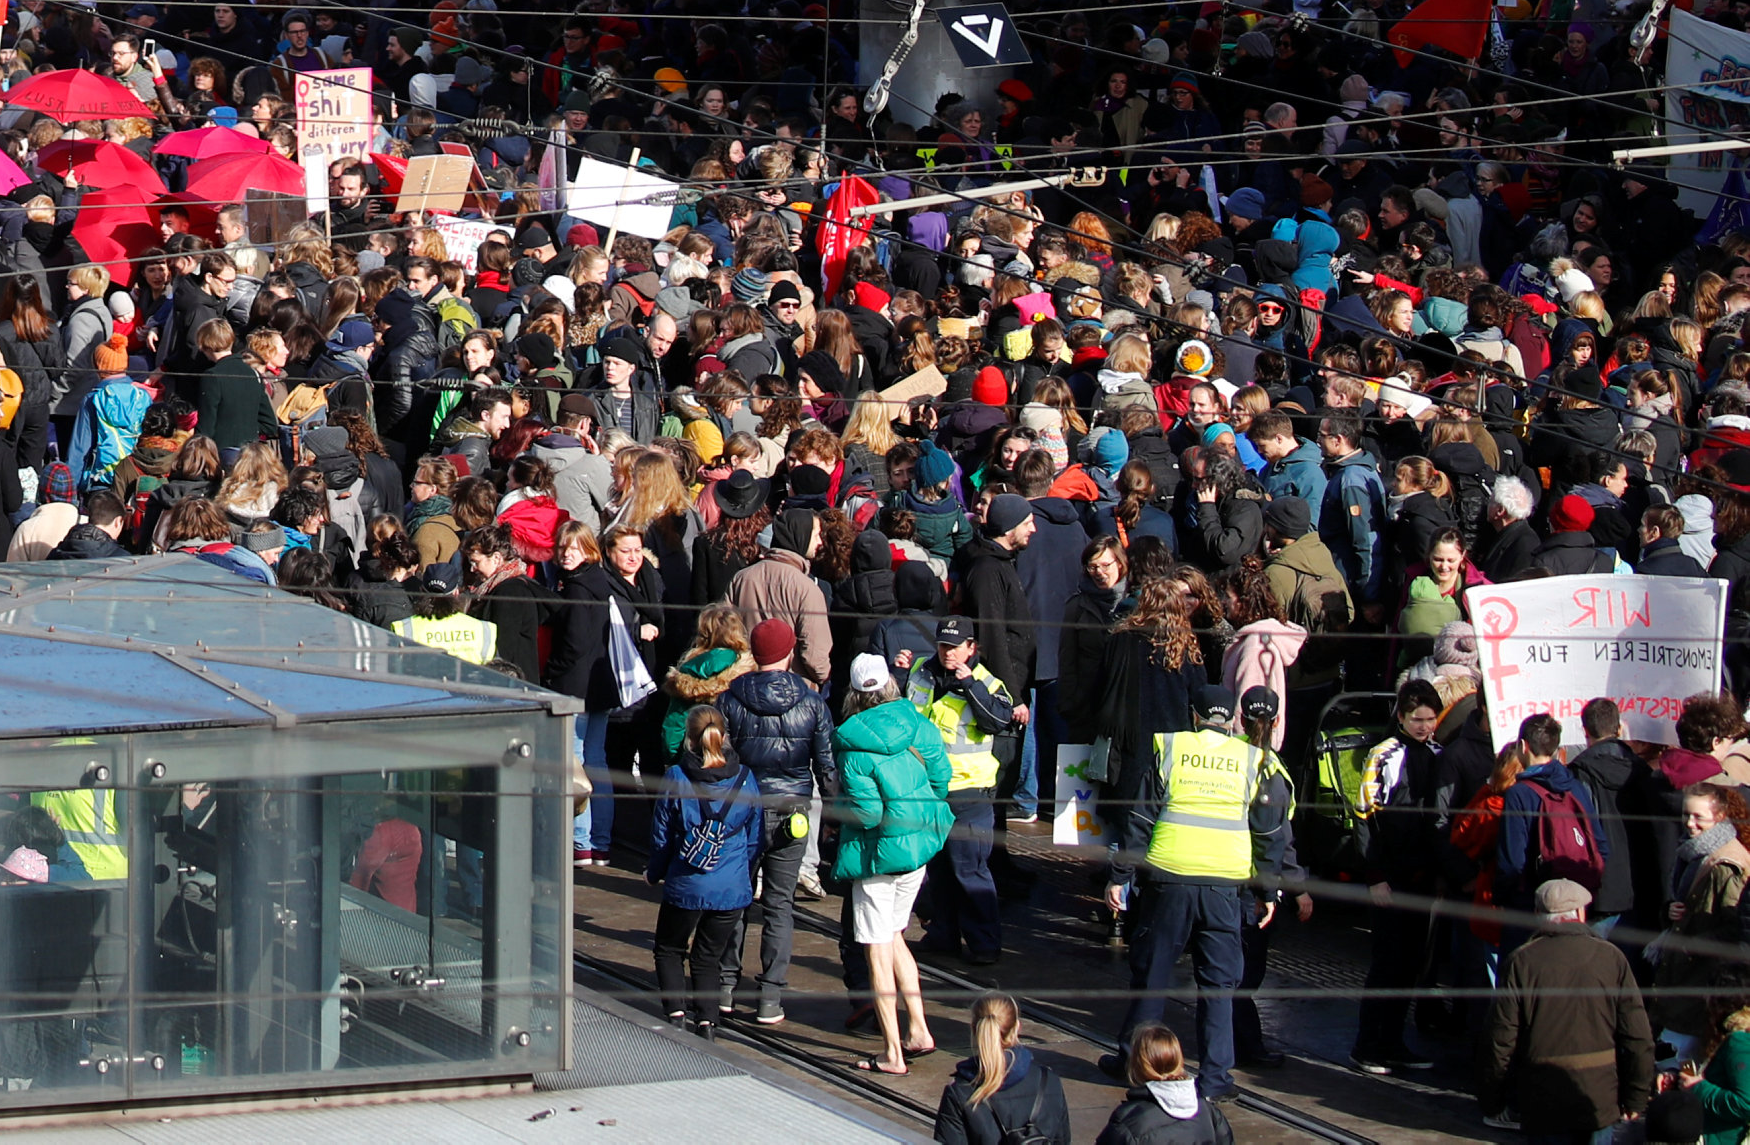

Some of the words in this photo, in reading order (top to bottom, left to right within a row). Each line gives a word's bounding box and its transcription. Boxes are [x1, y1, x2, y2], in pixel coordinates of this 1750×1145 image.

[312, 73, 356, 89] same
[25, 90, 65, 111] LUST
[426, 629, 475, 644] POLIZEI
[1208, 706, 1230, 716] POLIZEI
[1181, 753, 1240, 773] POLIZEI
